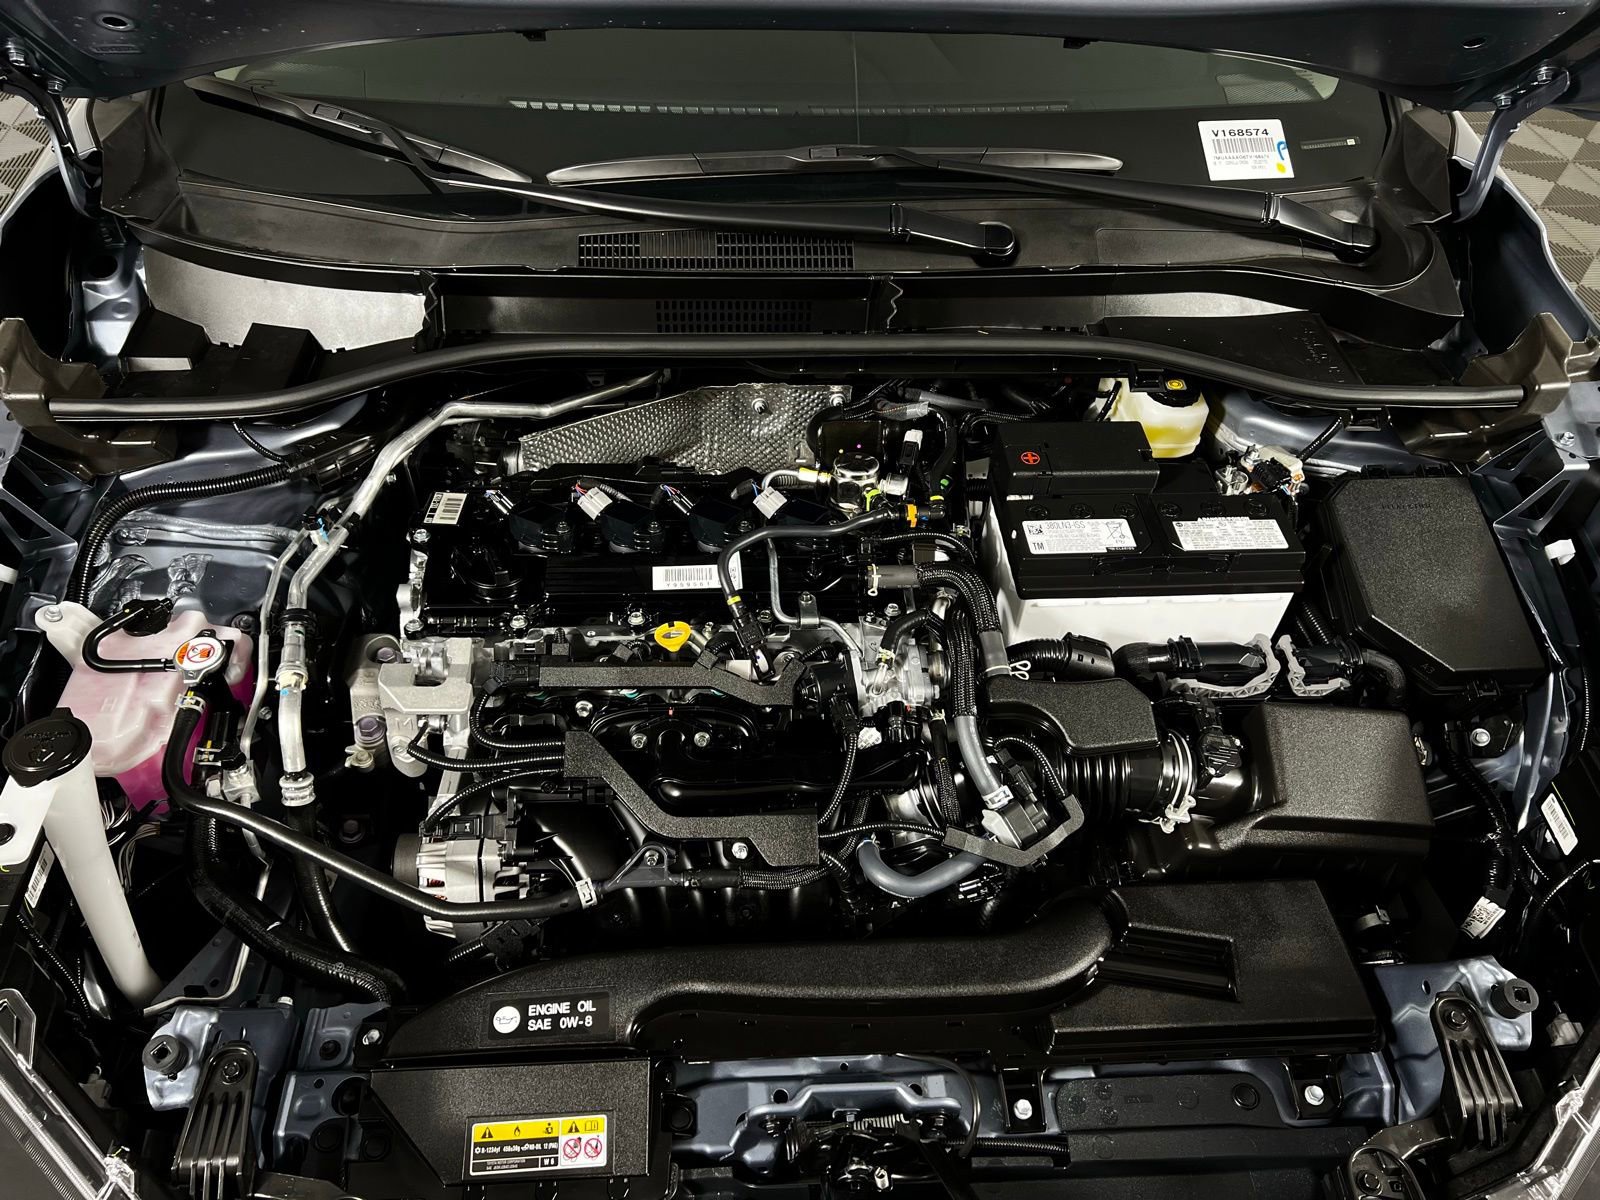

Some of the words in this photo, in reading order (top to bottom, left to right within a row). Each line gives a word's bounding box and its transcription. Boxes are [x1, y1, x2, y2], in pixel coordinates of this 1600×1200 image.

[1211, 128, 1270, 137] V168574
[1032, 542, 1045, 551] TM
[528, 1001, 571, 1016] ENGINE
[577, 1000, 597, 1012] OIL
[527, 1018, 552, 1031] SAE
[559, 1015, 593, 1029] 0W-8
